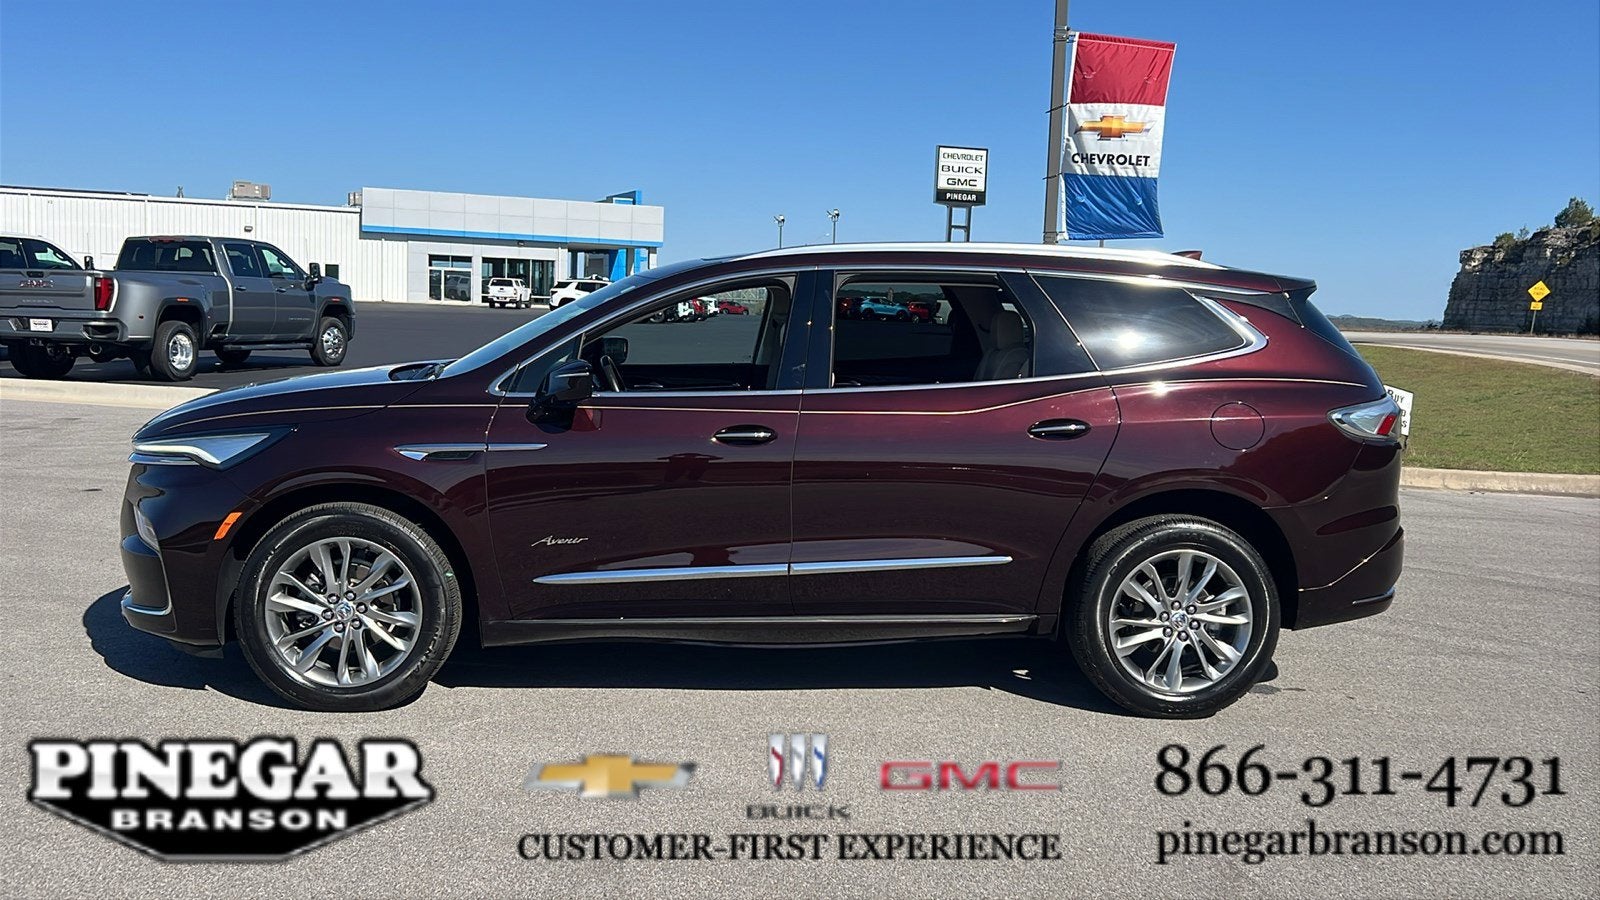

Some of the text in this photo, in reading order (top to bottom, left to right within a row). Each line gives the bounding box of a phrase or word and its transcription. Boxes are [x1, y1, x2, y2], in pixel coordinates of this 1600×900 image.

[942, 152, 984, 161] CHEVROLET
[1071, 153, 1151, 167] CHEVROLET
[941, 164, 983, 174] BUICK
[946, 177, 977, 187] GMC
[946, 192, 977, 201] PINEGAR
[531, 535, 589, 546] Avenir
